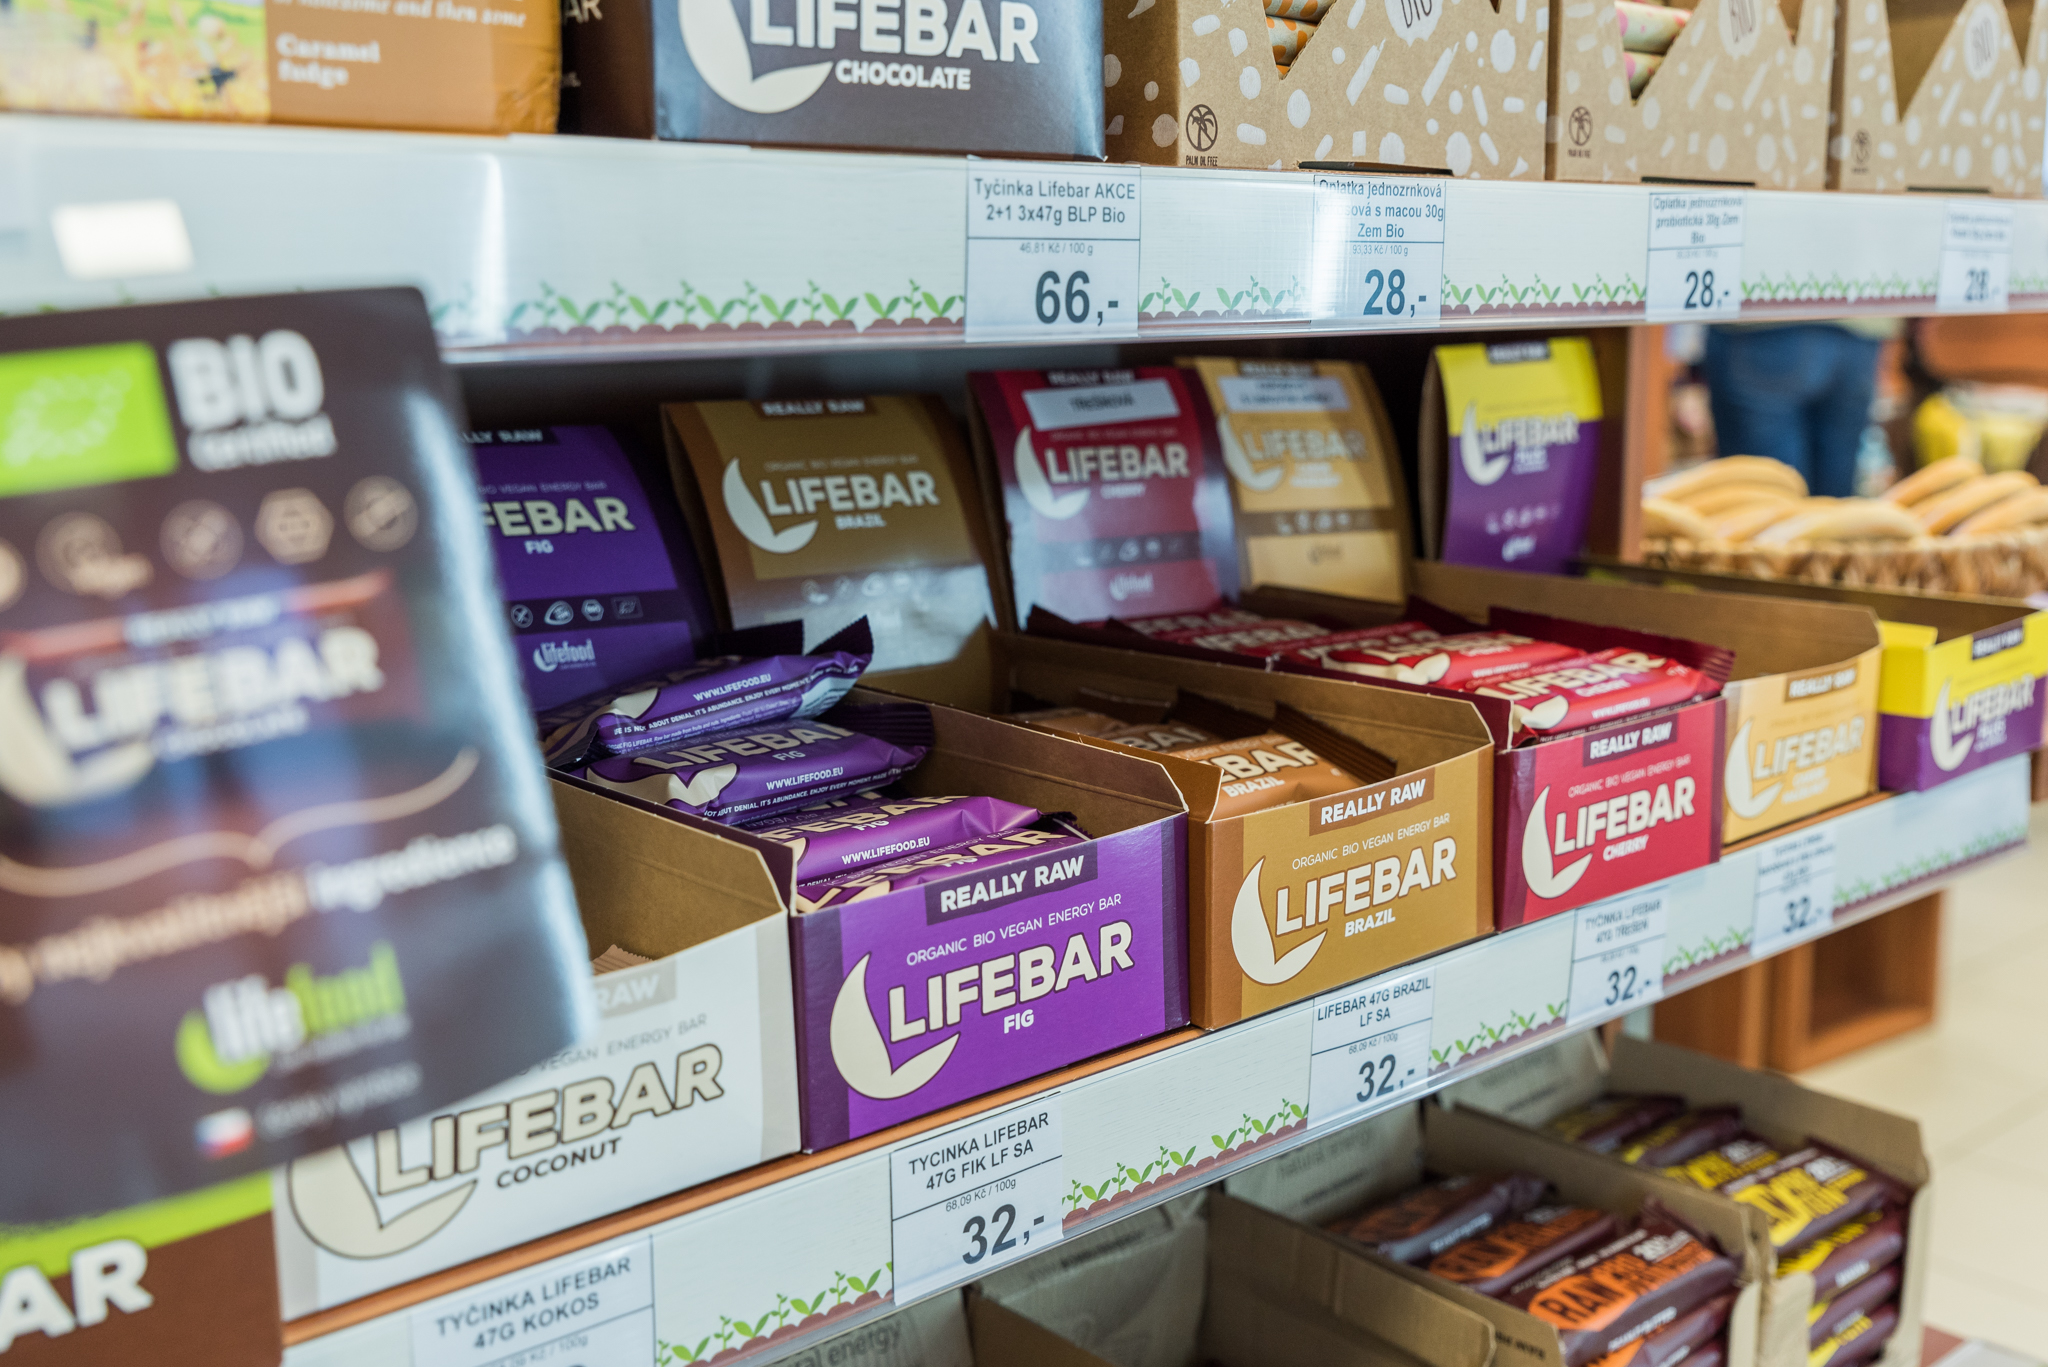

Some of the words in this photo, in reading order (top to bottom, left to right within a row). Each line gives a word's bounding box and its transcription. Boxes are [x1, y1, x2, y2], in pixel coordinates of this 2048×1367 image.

[275, 32, 381, 63] Caramel
[750, 0, 1040, 64] LIFEBAR
[835, 59, 971, 90] CHOCOLATE
[1186, 154, 1199, 166] PALM
[1207, 156, 1218, 167] FREE
[974, 177, 1034, 198] Tyčinka
[1039, 180, 1091, 199] Lifebar
[1095, 183, 1137, 200] AKCE
[1367, 181, 1442, 199] jednozrnková
[985, 205, 1013, 221] 2+1
[1018, 205, 1063, 227] 3x47g
[1068, 206, 1097, 223] BLP
[1102, 207, 1126, 224] Bio
[1357, 223, 1382, 237] Zem
[1386, 223, 1405, 238] Bio
[1375, 208, 1381, 216] s
[1385, 207, 1422, 217] macou
[1425, 204, 1444, 221] 30g
[1020, 242, 1046, 256] 46,81
[1048, 242, 1060, 255] Kč
[1069, 243, 1085, 255] 100
[1087, 245, 1094, 257] g
[1352, 245, 1372, 256] 93,33
[1374, 245, 1383, 254] Kč
[1390, 245, 1402, 254] 100
[1034, 269, 1119, 328] 66,-
[1363, 269, 1427, 318] 28,-
[167, 329, 324, 432] BIO
[1044, 442, 1190, 484] LIFEBAR
[761, 470, 939, 516] LIFEBAR
[524, 539, 554, 555] FIG
[693, 673, 772, 702] WWW.LIFEFOOD.EU
[648, 718, 670, 729] ABOUT
[694, 708, 707, 717] IT'S
[745, 692, 764, 702] ENJOY
[772, 750, 806, 761] FIG
[1589, 730, 1640, 759] REALLY
[1641, 721, 1673, 747] RAW
[1753, 716, 1865, 780] LIFEBAR
[766, 766, 844, 791] WWW.LIFEFOOD.EU
[772, 791, 809, 804] ABUNDANCE.
[809, 787, 828, 795] ENJOY
[829, 782, 847, 791] EVERY
[1221, 775, 1286, 798] BRAZIL
[1320, 790, 1387, 826] REALLY
[1390, 778, 1426, 806] RAW
[1553, 775, 1696, 856] LIFEBAR
[851, 820, 889, 831] FIG
[1291, 847, 1339, 871] ORGANIC
[1342, 842, 1360, 857] BIO
[1361, 832, 1395, 851] VEGAN
[1397, 820, 1431, 842] ENERGY
[1433, 812, 1451, 829] BAR
[841, 836, 931, 865] WWW.LIFEFOOD.EU
[1602, 834, 1650, 862] CHERRY
[940, 870, 1028, 914] REALLY
[1034, 855, 1085, 889] RAW
[1275, 836, 1458, 937] LIFEBAR
[905, 937, 968, 967] ORGANIC
[972, 930, 996, 949] BIO
[999, 917, 1043, 941] VEGAN
[1048, 901, 1096, 927] ENERGY
[1098, 892, 1122, 911] BAR
[1344, 908, 1397, 938] BRAZIL
[887, 919, 1135, 1044] LIFEBAR
[1317, 995, 1367, 1021] LIFEBAR
[1369, 989, 1390, 1006] 47G
[1393, 977, 1431, 999] BRAZIL
[606, 1024, 674, 1056] ENERGY
[677, 1013, 708, 1035] BAR
[1002, 1008, 1036, 1034] FIG
[1359, 1011, 1373, 1028] LF
[1375, 1007, 1391, 1022] SA
[1355, 1053, 1415, 1103] 32,-
[373, 1042, 726, 1198] LIFEBAR
[908, 1138, 980, 1176] TYCINKA
[984, 1111, 1049, 1149] LIFEBAR
[496, 1137, 622, 1189] COCONUT
[925, 1167, 956, 1191] 47G
[961, 1156, 987, 1179] FIK
[991, 1148, 1009, 1168] LF
[1013, 1139, 1034, 1158] SA
[945, 1194, 972, 1212] 68,09
[974, 1186, 988, 1202] Kč
[995, 1178, 1017, 1194] 100g
[961, 1203, 1045, 1265] 32,-
[541, 1256, 631, 1302] LIFEBAR
[473, 1321, 516, 1350] 47G
[522, 1291, 600, 1334] KOKOS
